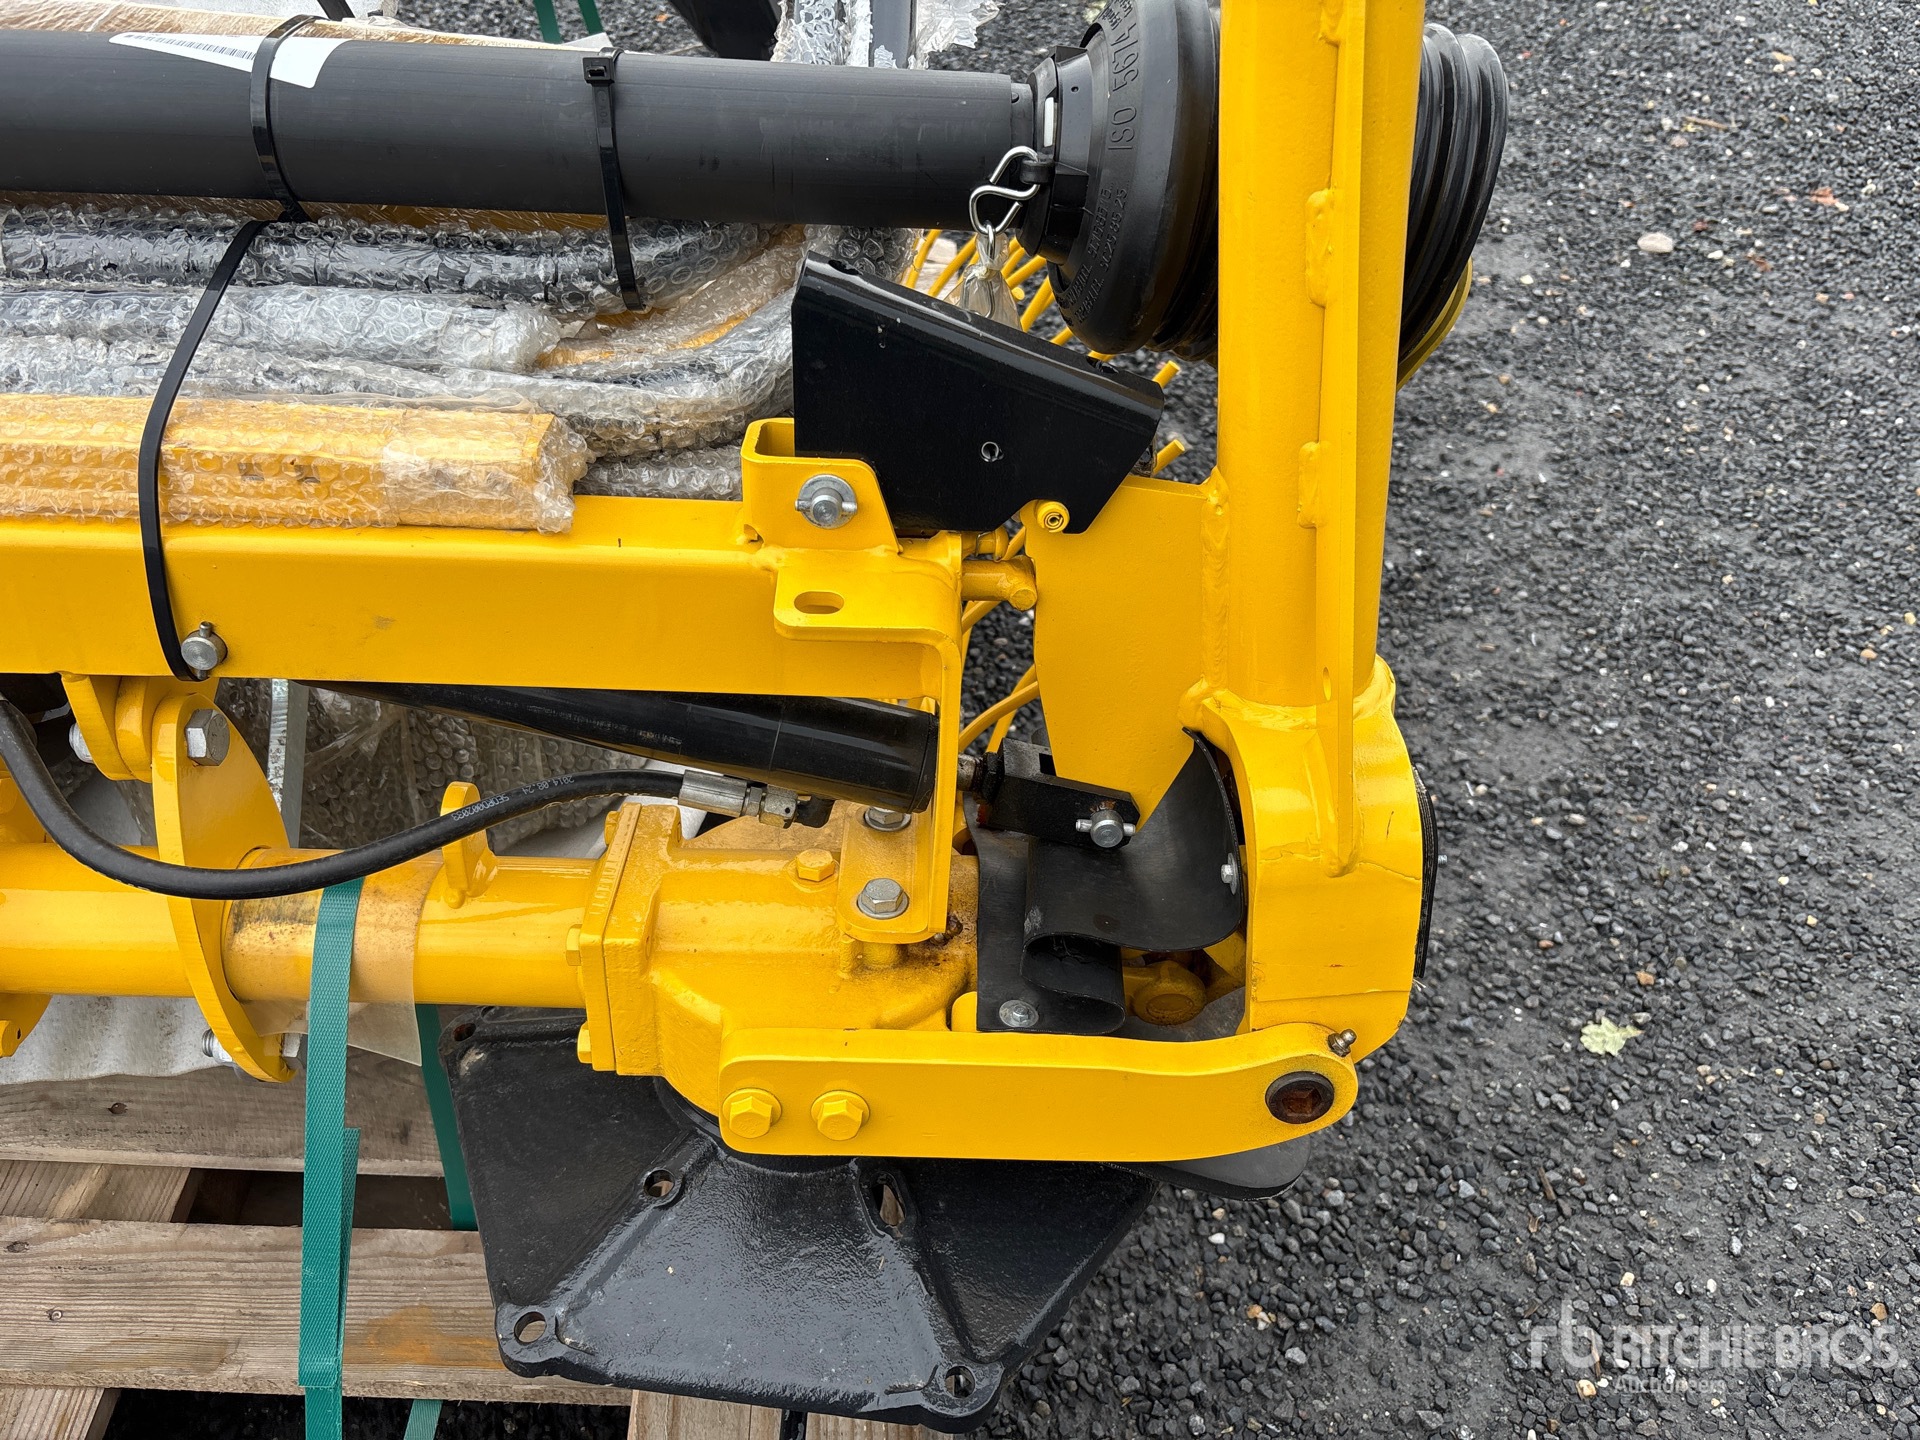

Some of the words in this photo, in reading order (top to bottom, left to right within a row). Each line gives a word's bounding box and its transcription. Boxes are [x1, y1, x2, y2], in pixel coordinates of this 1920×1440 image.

[1110, 22, 1139, 92] 5674
[1107, 106, 1137, 150] ISO
[522, 775, 575, 795] 2014.08.24
